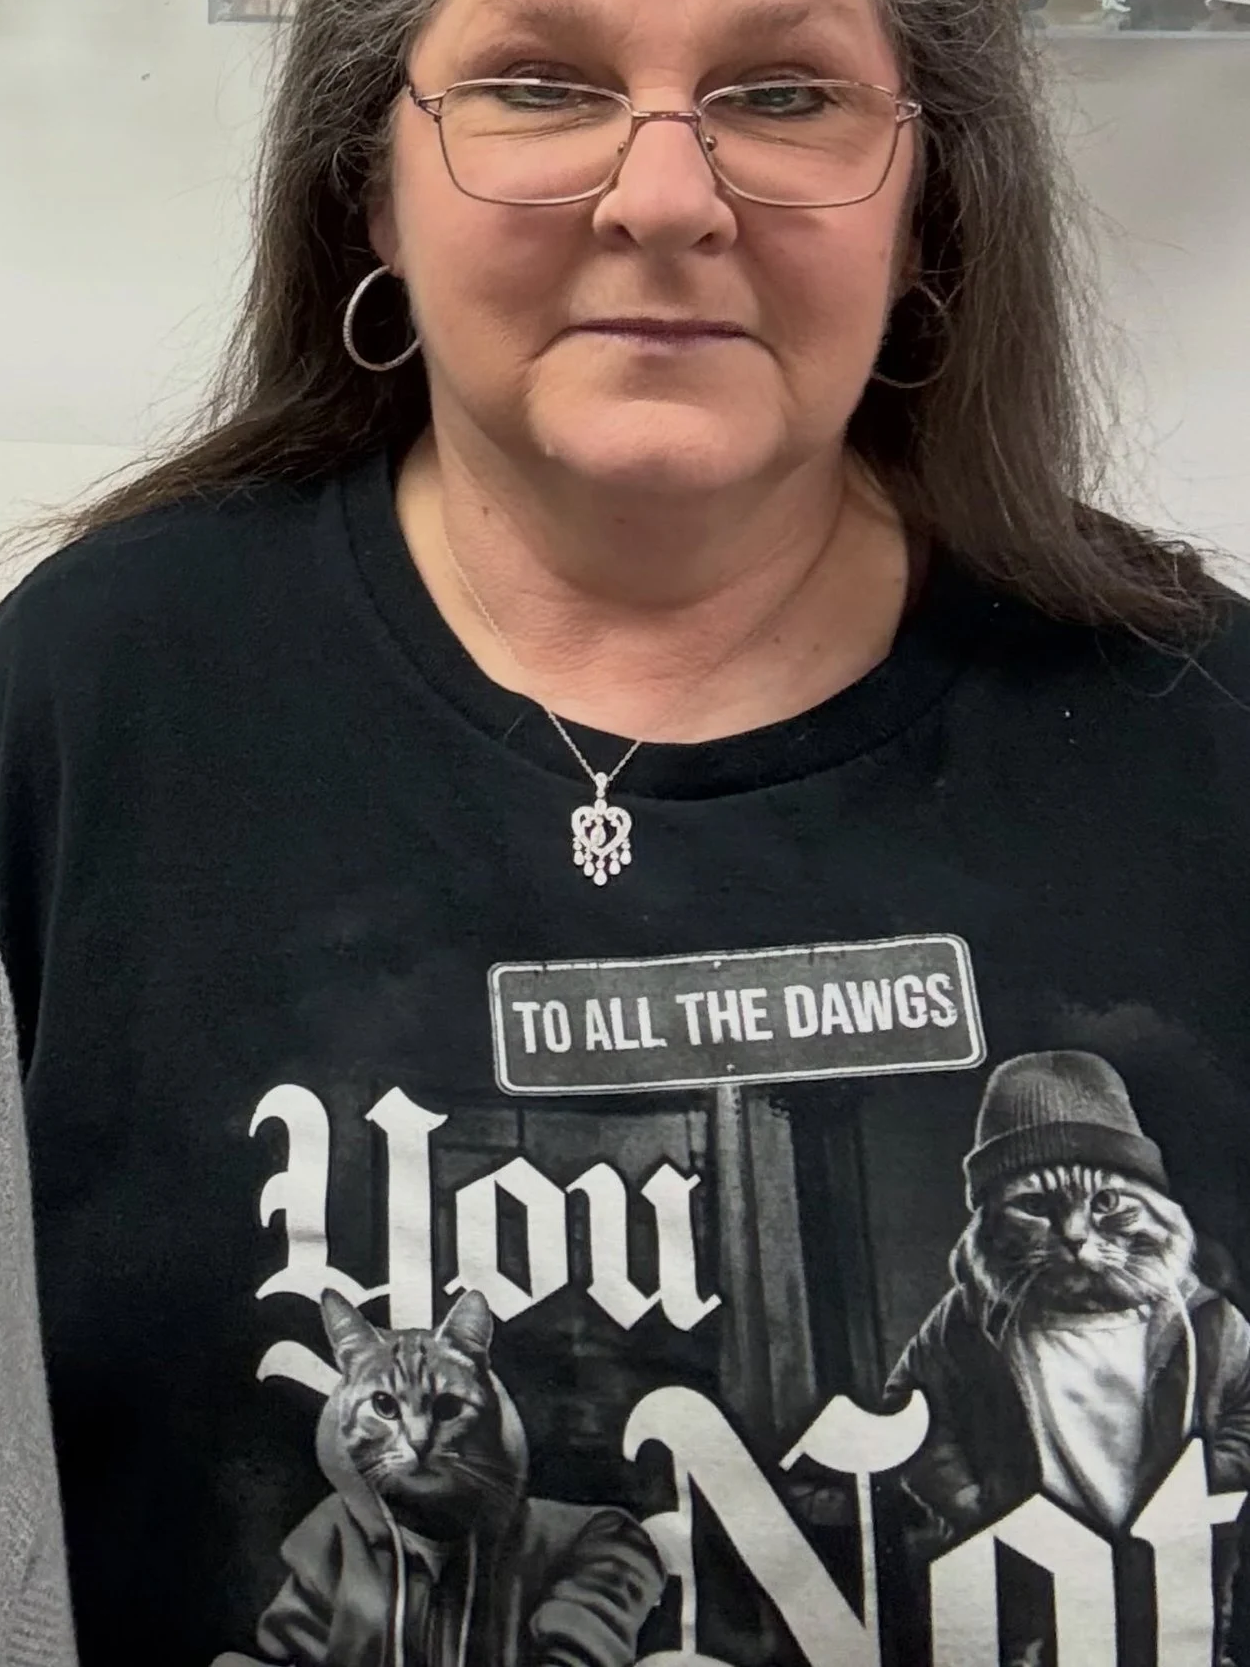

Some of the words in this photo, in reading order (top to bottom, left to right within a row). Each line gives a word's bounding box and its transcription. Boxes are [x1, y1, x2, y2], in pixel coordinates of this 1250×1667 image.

[513, 1001, 571, 1053] TO
[585, 996, 668, 1051] ALL
[676, 987, 774, 1045] THE
[783, 972, 958, 1038] DAWGS
[249, 1083, 722, 1396] You
[623, 1386, 1248, 1667] Not
